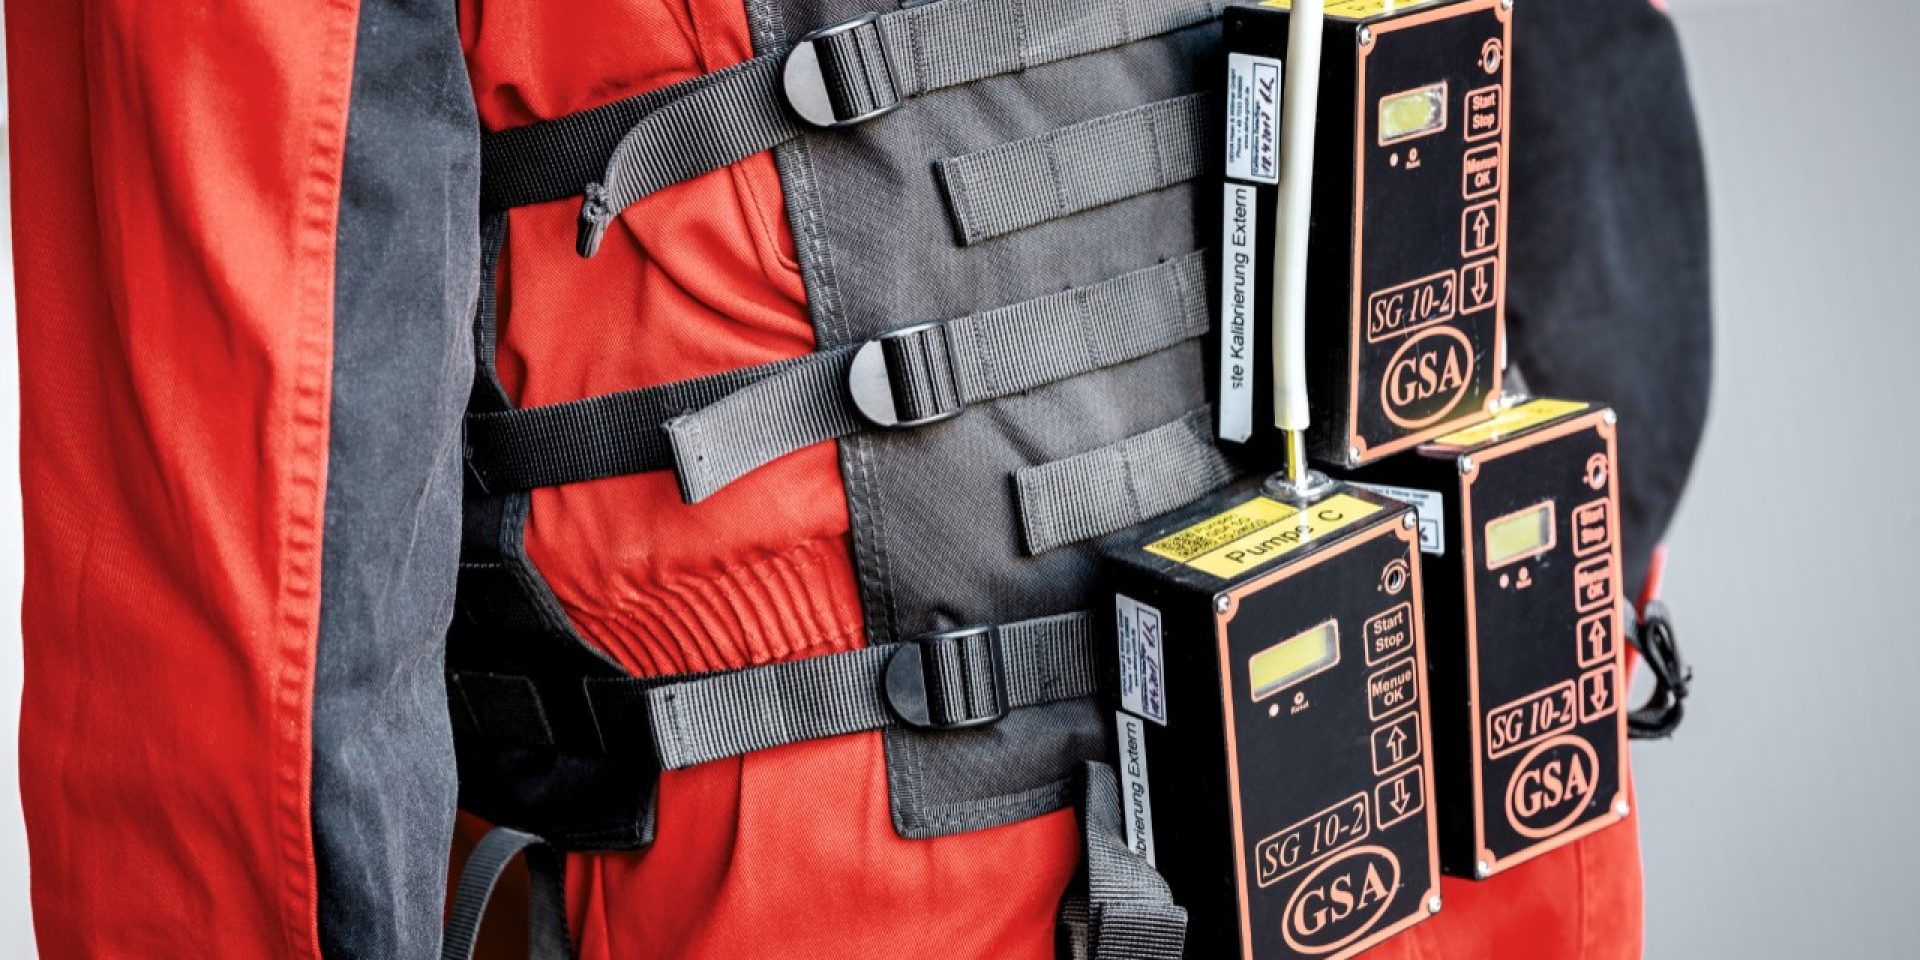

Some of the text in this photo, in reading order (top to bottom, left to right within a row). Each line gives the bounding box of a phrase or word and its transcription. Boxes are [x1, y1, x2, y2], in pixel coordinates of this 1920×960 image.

[1474, 170, 1491, 187] OK
[1232, 188, 1247, 247] Extern
[1231, 252, 1249, 360] Kalibrierung
[1372, 278, 1453, 333] SG 10-2
[1390, 345, 1462, 406] GSA
[1317, 509, 1344, 522] C
[1373, 611, 1404, 634] Start
[1375, 632, 1405, 652] Stop
[1372, 669, 1412, 697] Menue
[1384, 686, 1405, 706] OK
[1493, 689, 1573, 750] SG 10-2
[1125, 721, 1141, 778] Extern
[1514, 752, 1589, 817] GSA
[1263, 801, 1365, 878] SG 10-2
[1294, 861, 1390, 937] GSA
